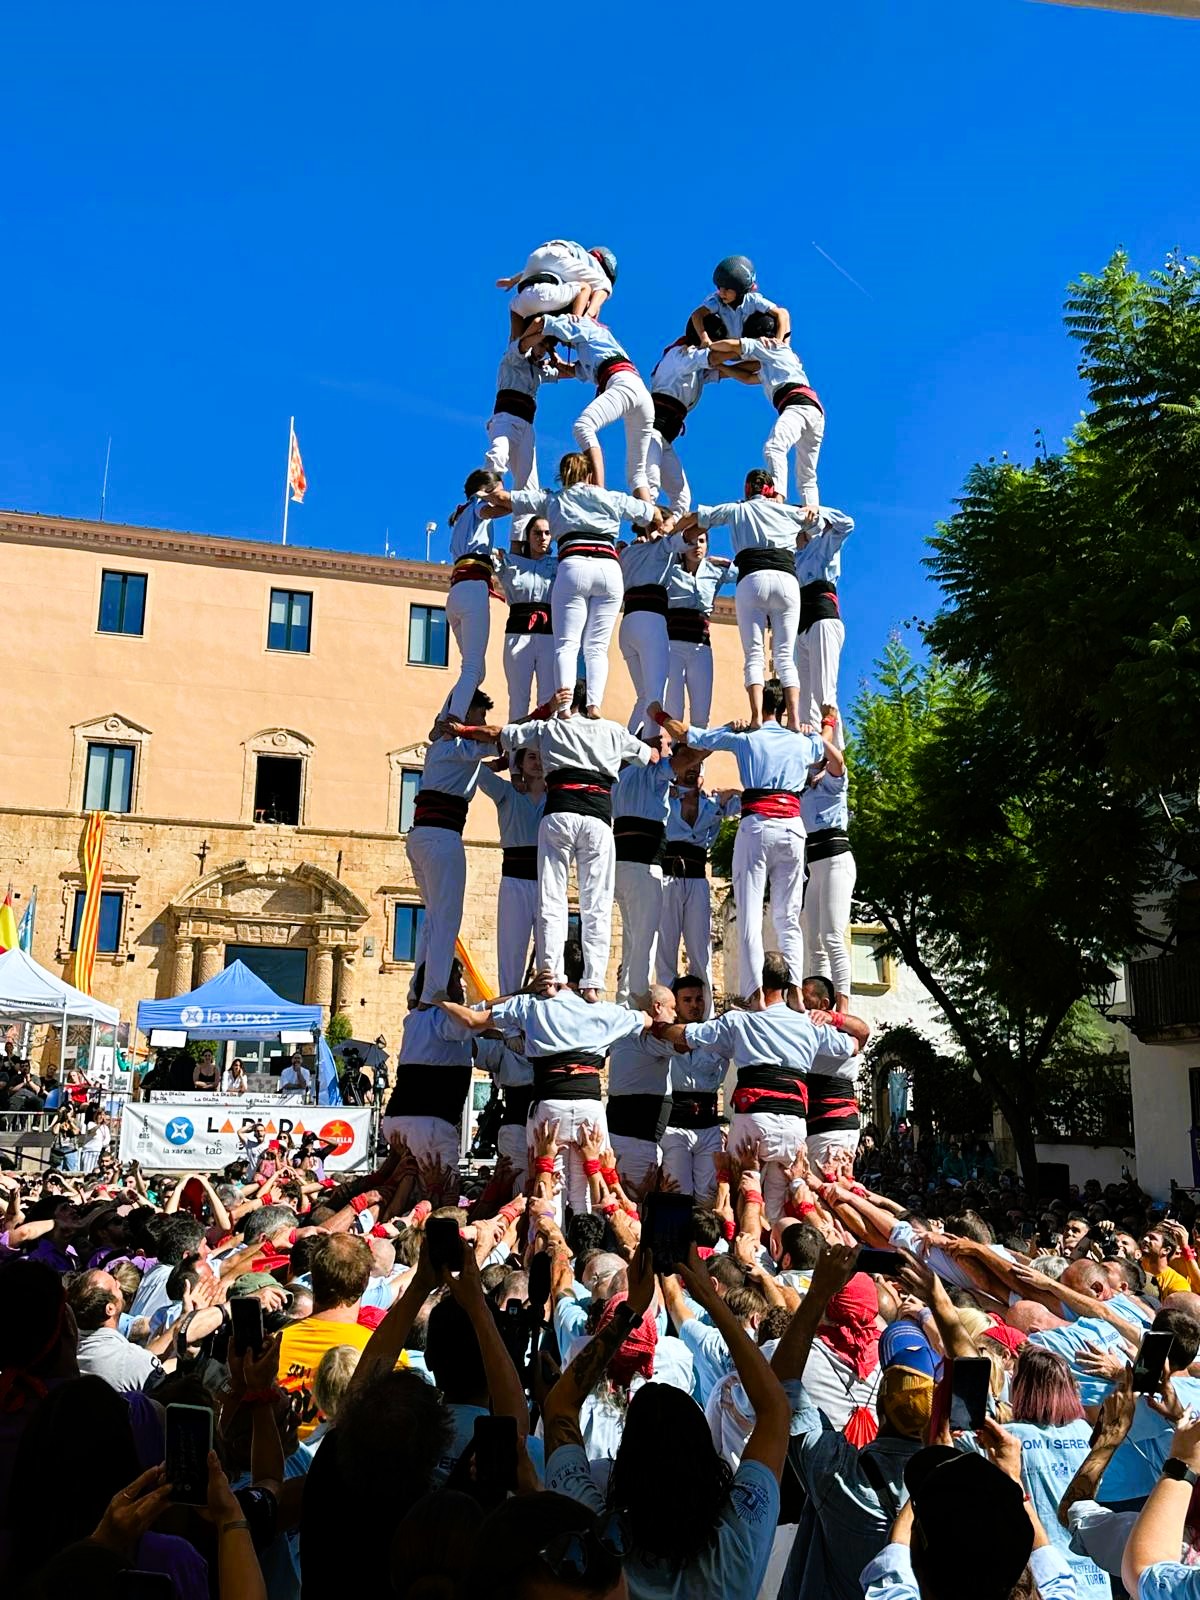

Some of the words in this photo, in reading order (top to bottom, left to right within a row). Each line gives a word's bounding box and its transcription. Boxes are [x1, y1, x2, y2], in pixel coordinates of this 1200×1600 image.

[207, 1009, 221, 1023] la
[205, 1145, 222, 1155] tac
[1022, 1440, 1042, 1450] OM
